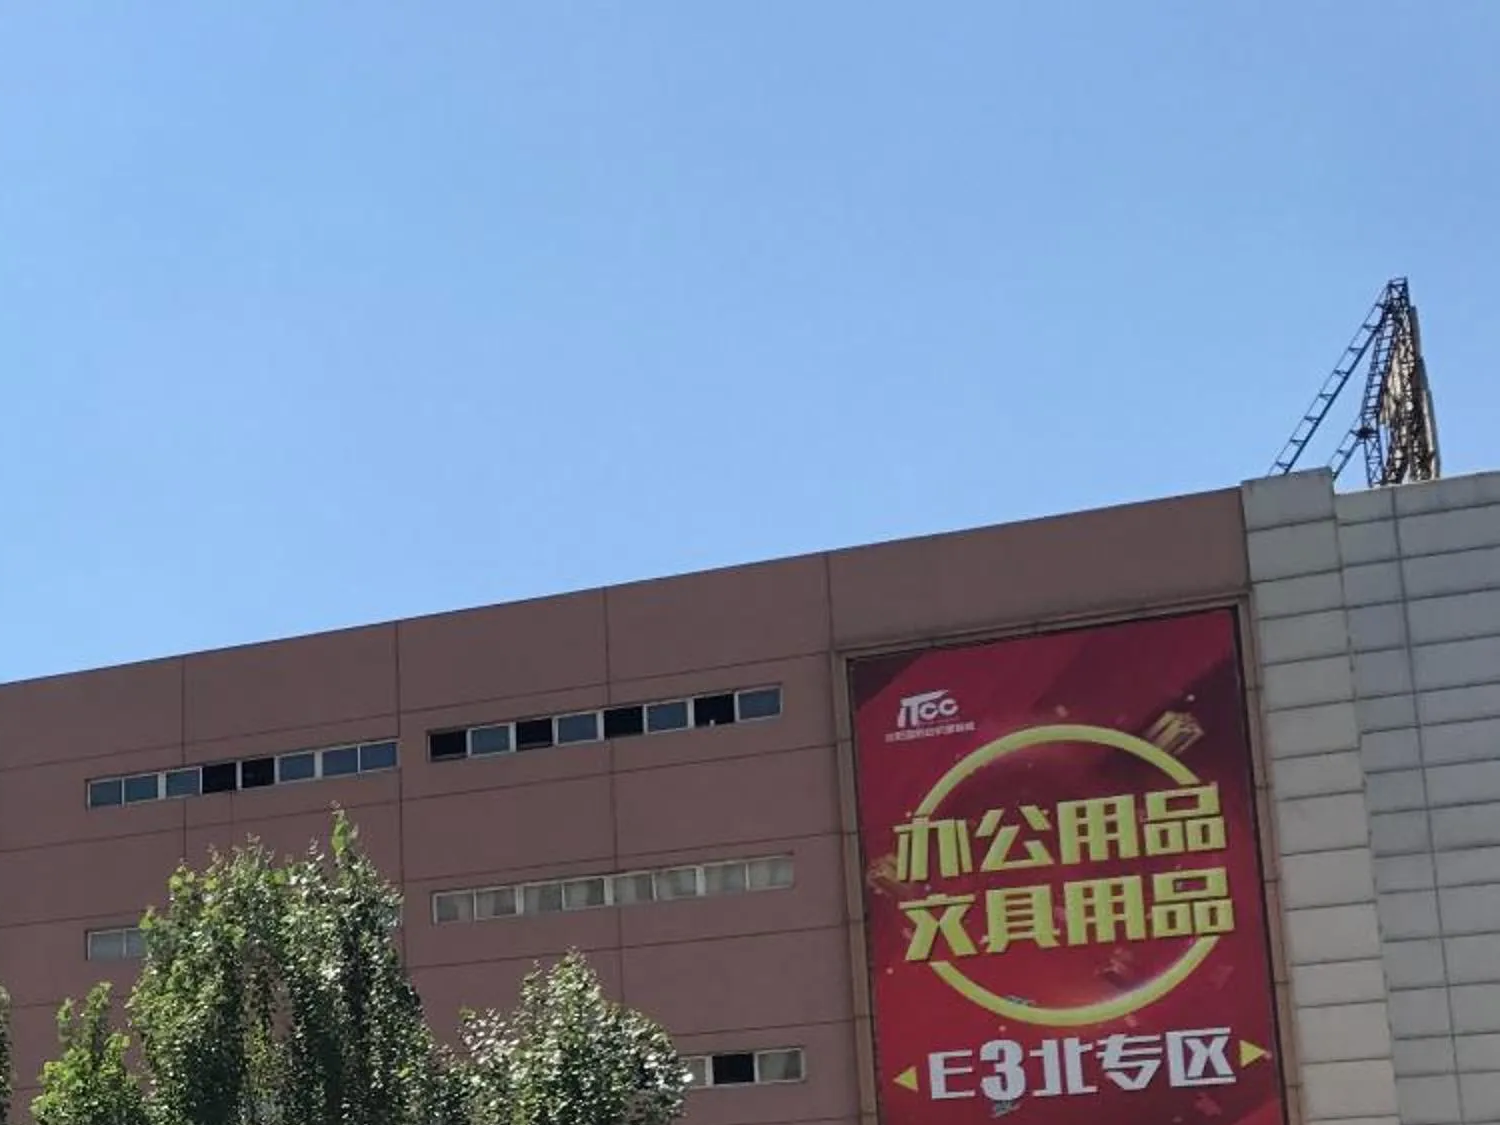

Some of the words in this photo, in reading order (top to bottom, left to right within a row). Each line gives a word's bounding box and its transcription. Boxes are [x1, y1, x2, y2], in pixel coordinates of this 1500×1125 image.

[893, 782, 1227, 883] 办公用品
[898, 866, 1235, 961] 文具用品
[928, 1027, 1237, 1102] E3北专区
